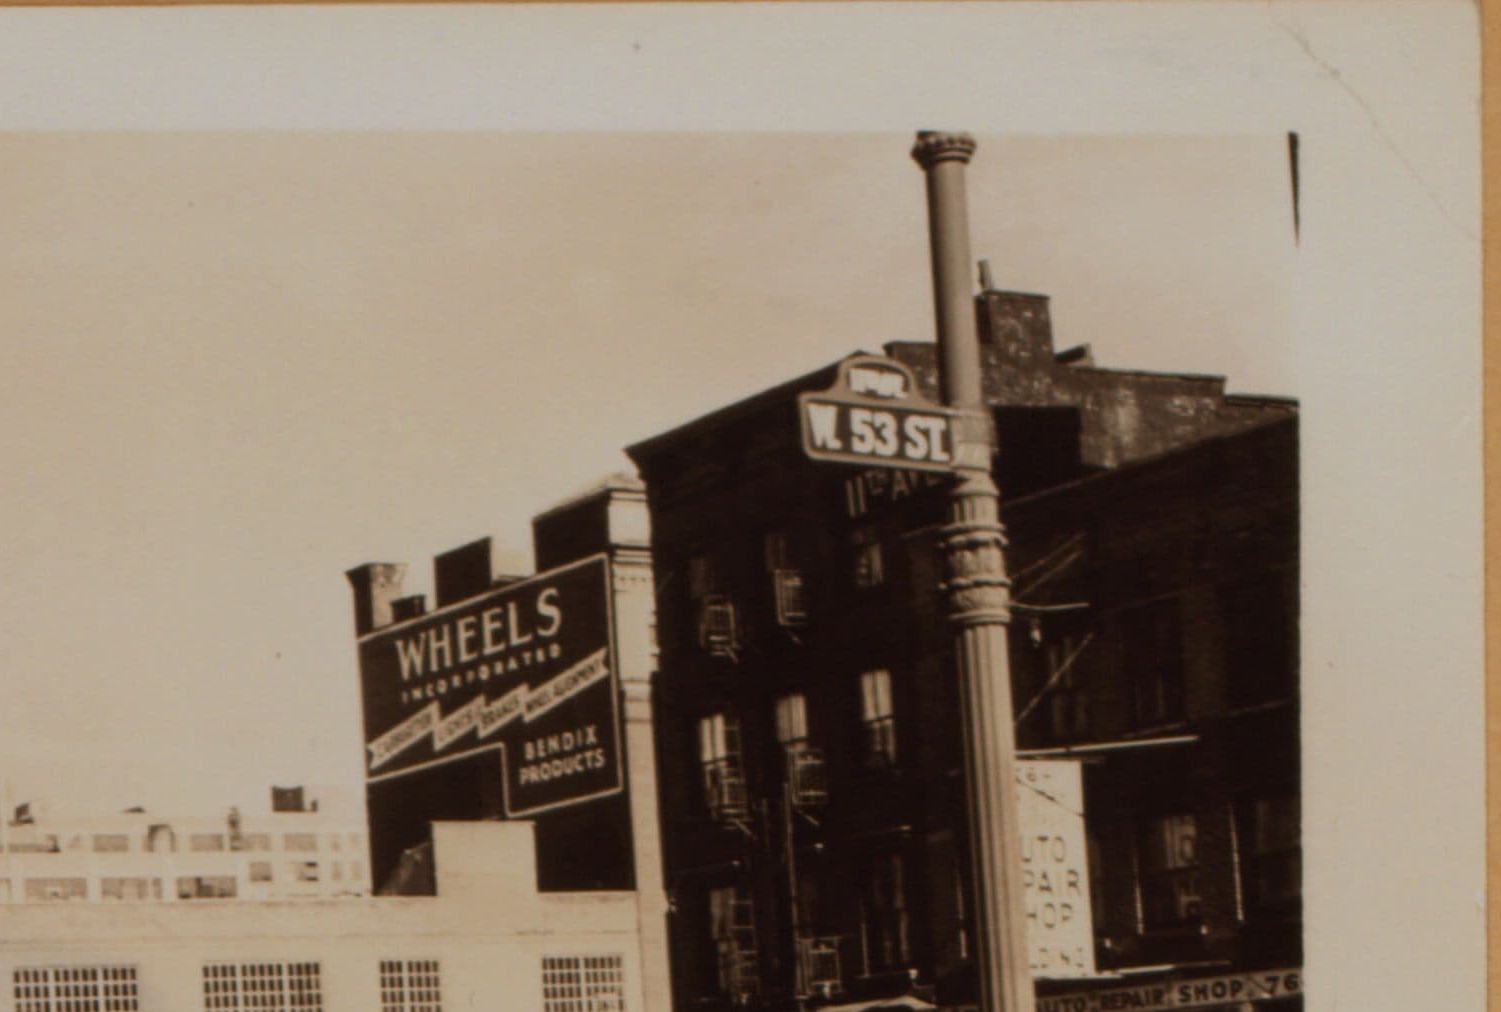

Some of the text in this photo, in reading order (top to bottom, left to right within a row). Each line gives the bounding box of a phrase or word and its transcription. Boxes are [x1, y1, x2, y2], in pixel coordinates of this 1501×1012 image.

[850, 407, 898, 457] 53
[395, 587, 562, 681] WHEELS
[402, 643, 561, 704] INCORPORATED
[523, 724, 598, 761] BENDIX
[519, 748, 606, 785] PRODUCTS
[1021, 834, 1066, 863] UTO
[1099, 987, 1164, 1010] REPAIR
[1179, 976, 1243, 1002] SHOP
